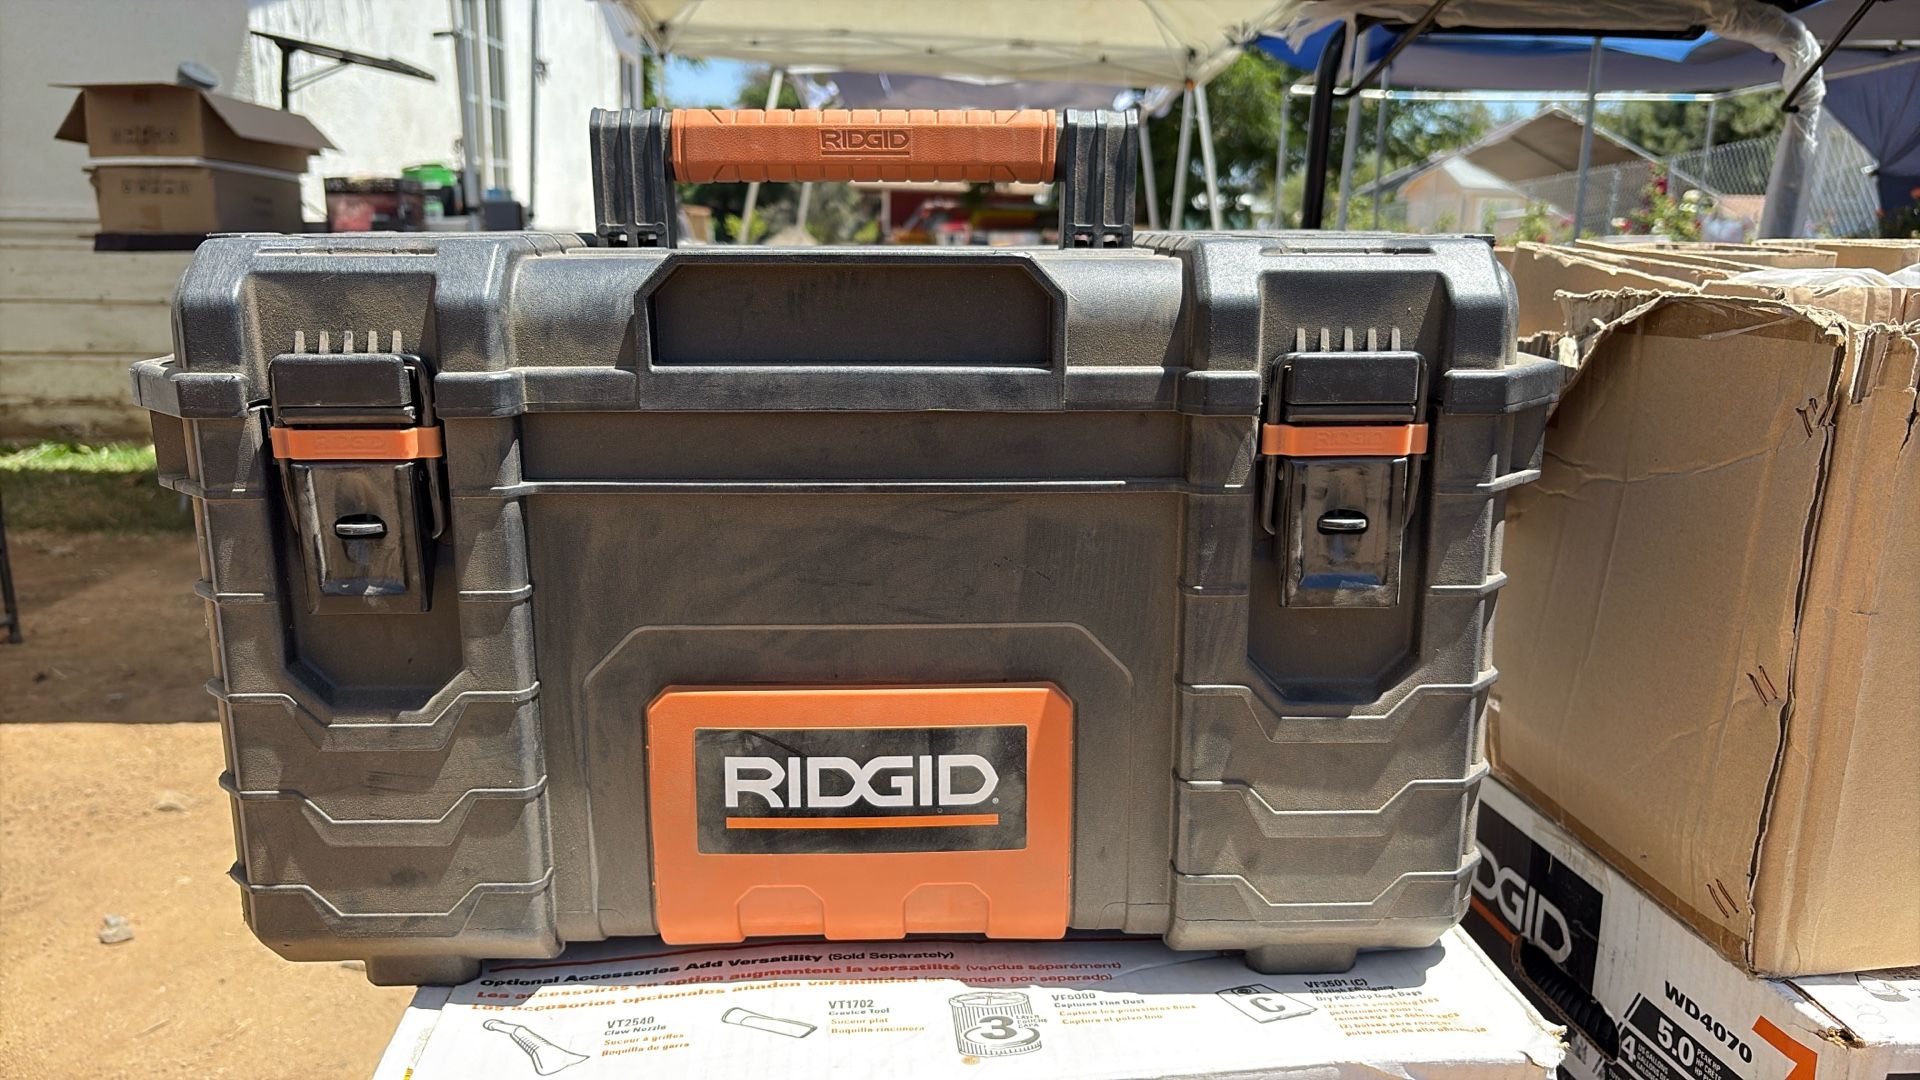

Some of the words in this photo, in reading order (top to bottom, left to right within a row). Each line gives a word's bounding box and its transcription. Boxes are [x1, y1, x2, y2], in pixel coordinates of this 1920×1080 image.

[820, 129, 910, 150] RIDGID
[724, 754, 1000, 808] RIDGID
[480, 975, 560, 987] Optional
[564, 965, 680, 983] Accessories
[685, 960, 723, 971] Add
[728, 954, 823, 967] Versatility
[828, 952, 865, 961] (Sold
[869, 951, 955, 961] Separately)
[664, 974, 724, 986] option
[729, 966, 842, 981] augmentent
[868, 963, 961, 973] versatilité
[966, 963, 1024, 972] (vendus
[1028, 961, 1122, 972] séparément)
[511, 999, 616, 1012] accesorios
[623, 989, 725, 1004] opcionales
[1010, 975, 1036, 984] por
[1040, 973, 1113, 983] separado)
[1304, 979, 1348, 988] VF3501
[1351, 978, 1368, 986] (C)
[828, 999, 875, 1010] VT1702
[1249, 996, 1286, 1012] C
[607, 1016, 655, 1029] VT2540
[633, 1024, 667, 1033] Nozzle
[979, 1016, 1018, 1040] 3
[1664, 980, 1753, 1064] WD4070
[647, 1044, 660, 1052] de
[662, 1042, 690, 1051] garra
[1621, 1035, 1636, 1063] 4
[1657, 1016, 1695, 1067] 5.0
[1645, 1050, 1668, 1075] GALLONS
[1695, 1057, 1704, 1068] HP
[1697, 1048, 1713, 1066] PEAK
[1712, 1061, 1721, 1072] HP
